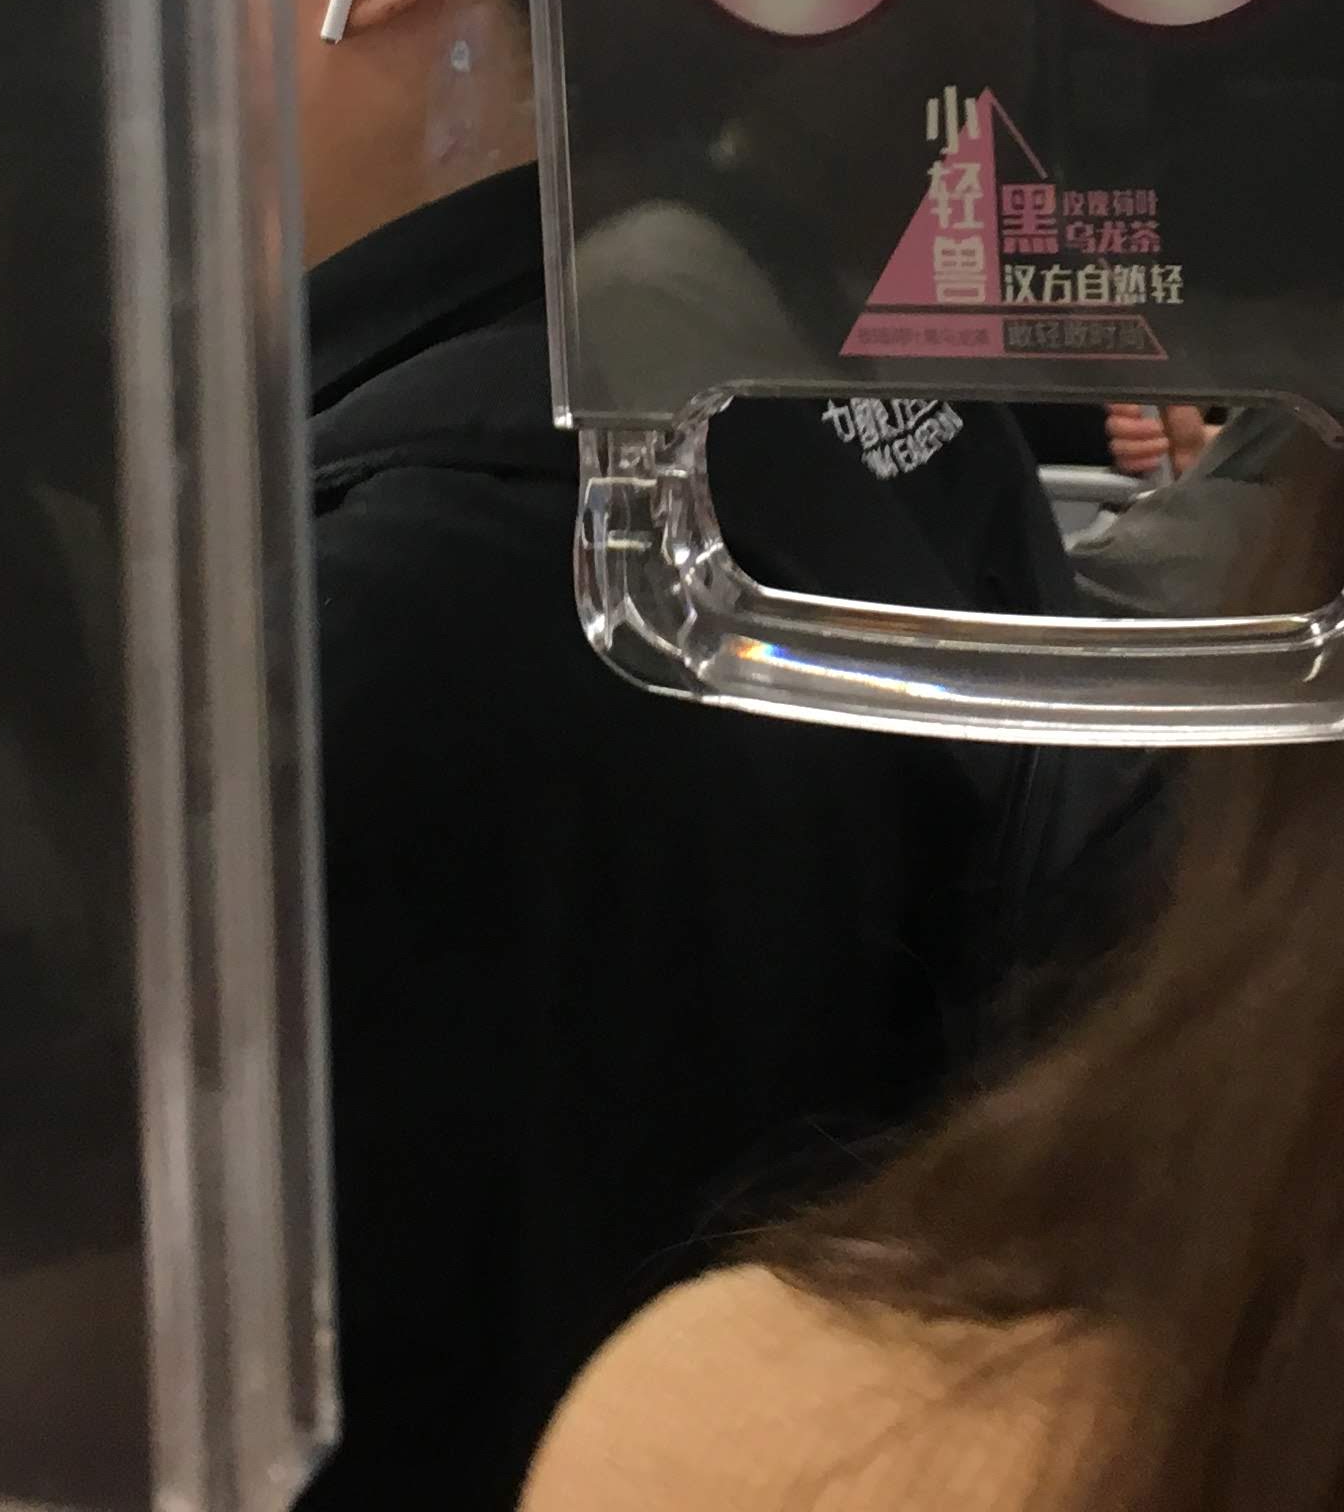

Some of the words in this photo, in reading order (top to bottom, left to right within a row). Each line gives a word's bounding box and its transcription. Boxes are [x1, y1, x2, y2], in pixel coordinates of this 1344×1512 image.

[1002, 184, 1059, 254] 黑
[1064, 221, 1161, 255] 乌龙茶
[1003, 263, 1184, 305] 汉方自然轻
